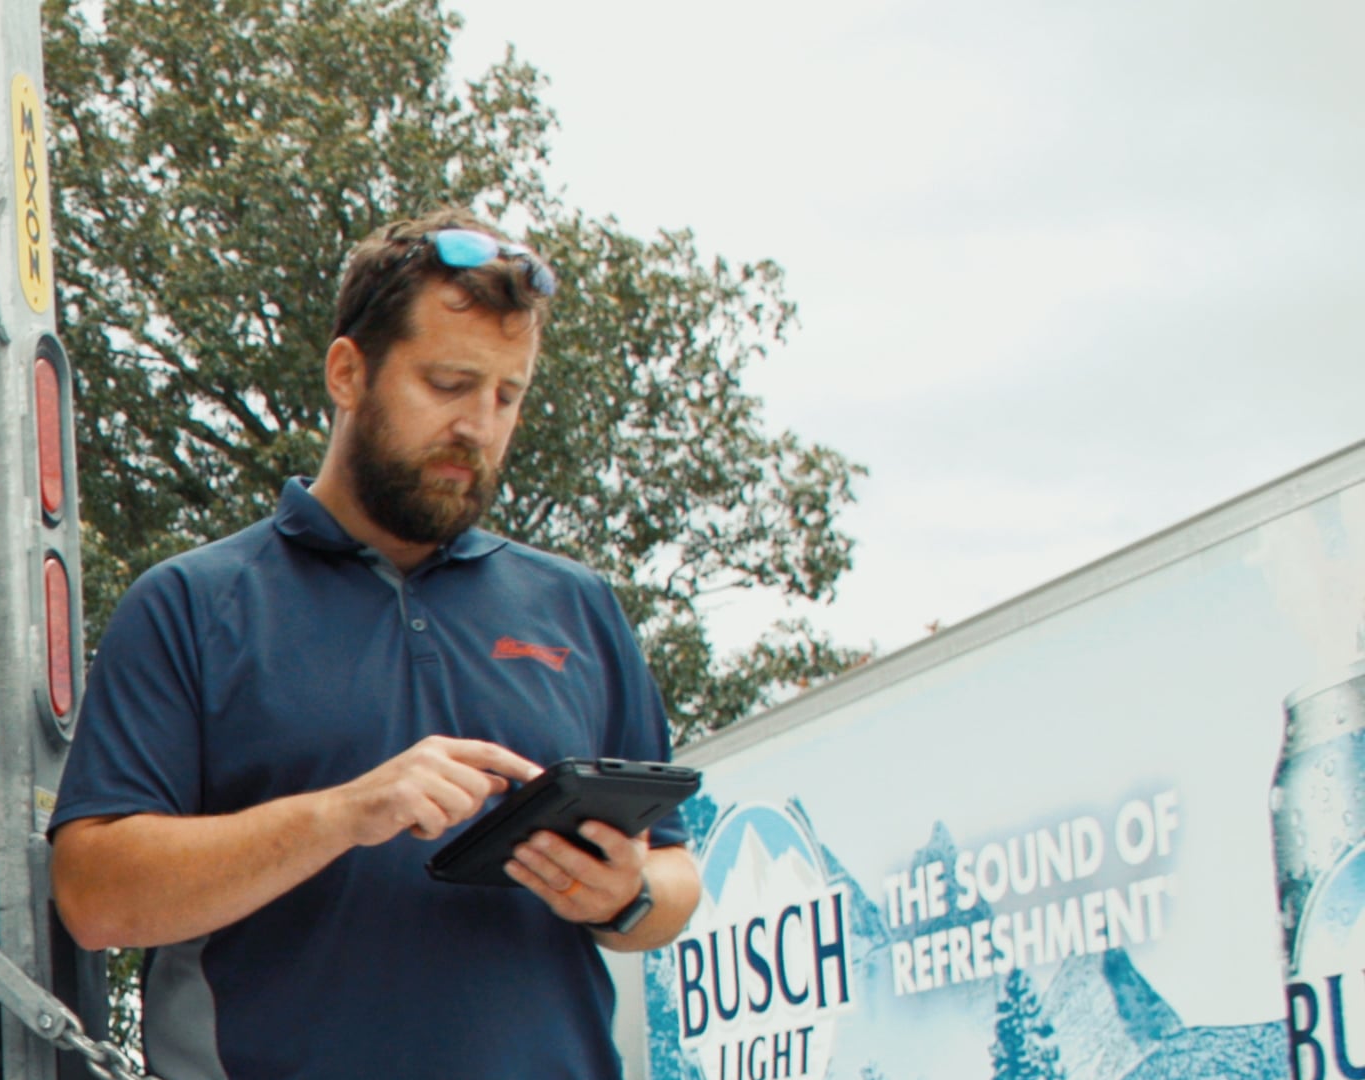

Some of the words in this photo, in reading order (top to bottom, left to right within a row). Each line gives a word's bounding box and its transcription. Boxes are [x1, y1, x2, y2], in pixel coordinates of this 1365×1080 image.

[21, 101, 41, 284] MAXON
[883, 860, 947, 929] THE
[954, 815, 1105, 911] SOUND
[1115, 791, 1178, 865] OF
[677, 892, 850, 1040] BUSCH
[891, 875, 1166, 997] REFRESHMENT
